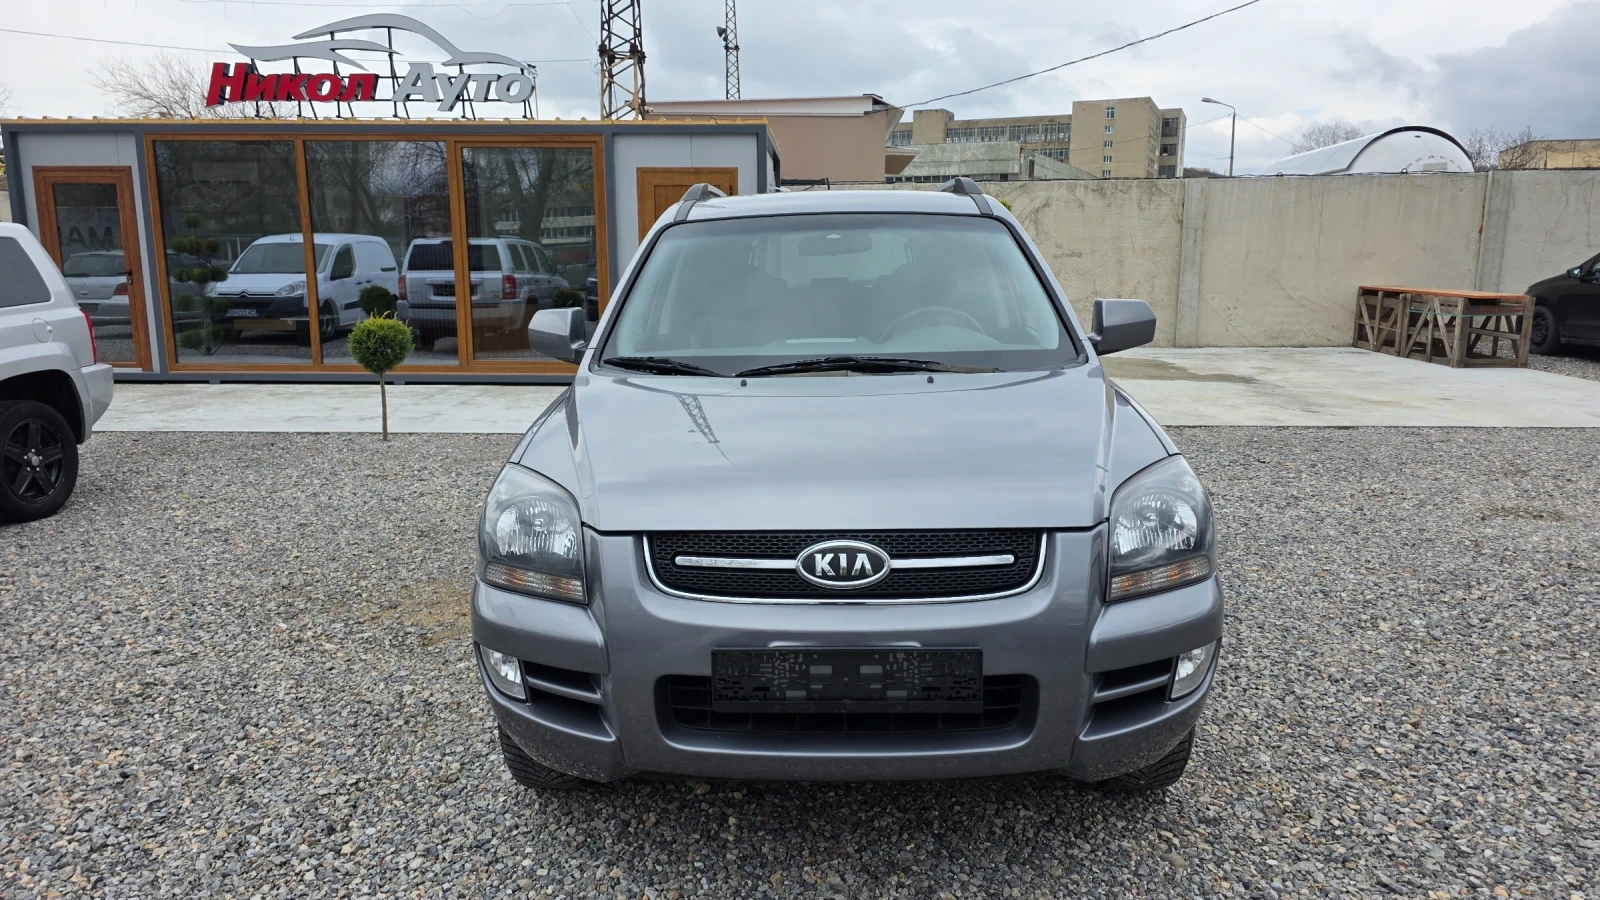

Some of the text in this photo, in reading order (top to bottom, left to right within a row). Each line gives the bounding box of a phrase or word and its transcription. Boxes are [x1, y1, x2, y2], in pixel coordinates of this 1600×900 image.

[206, 62, 534, 112] Никол Ауто
[813, 553, 874, 576] KIA
